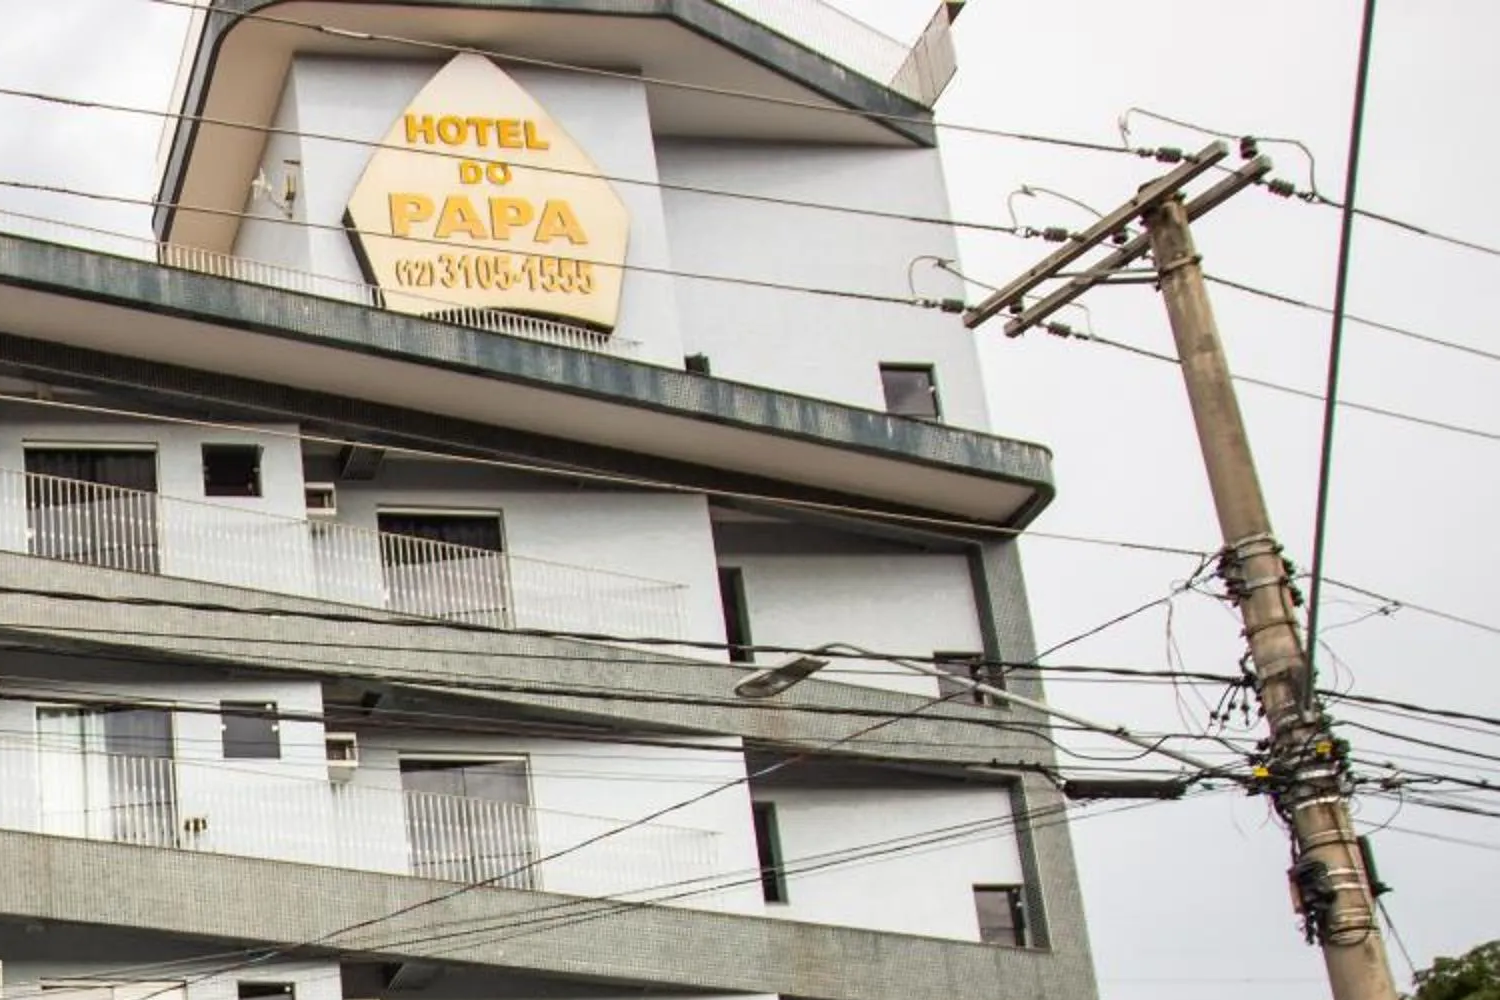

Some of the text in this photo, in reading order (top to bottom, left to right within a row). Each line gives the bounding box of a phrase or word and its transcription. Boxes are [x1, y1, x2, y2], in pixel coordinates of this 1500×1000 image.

[404, 113, 550, 151] HOTEL
[459, 161, 512, 185] DO
[388, 192, 588, 245] PAPA
